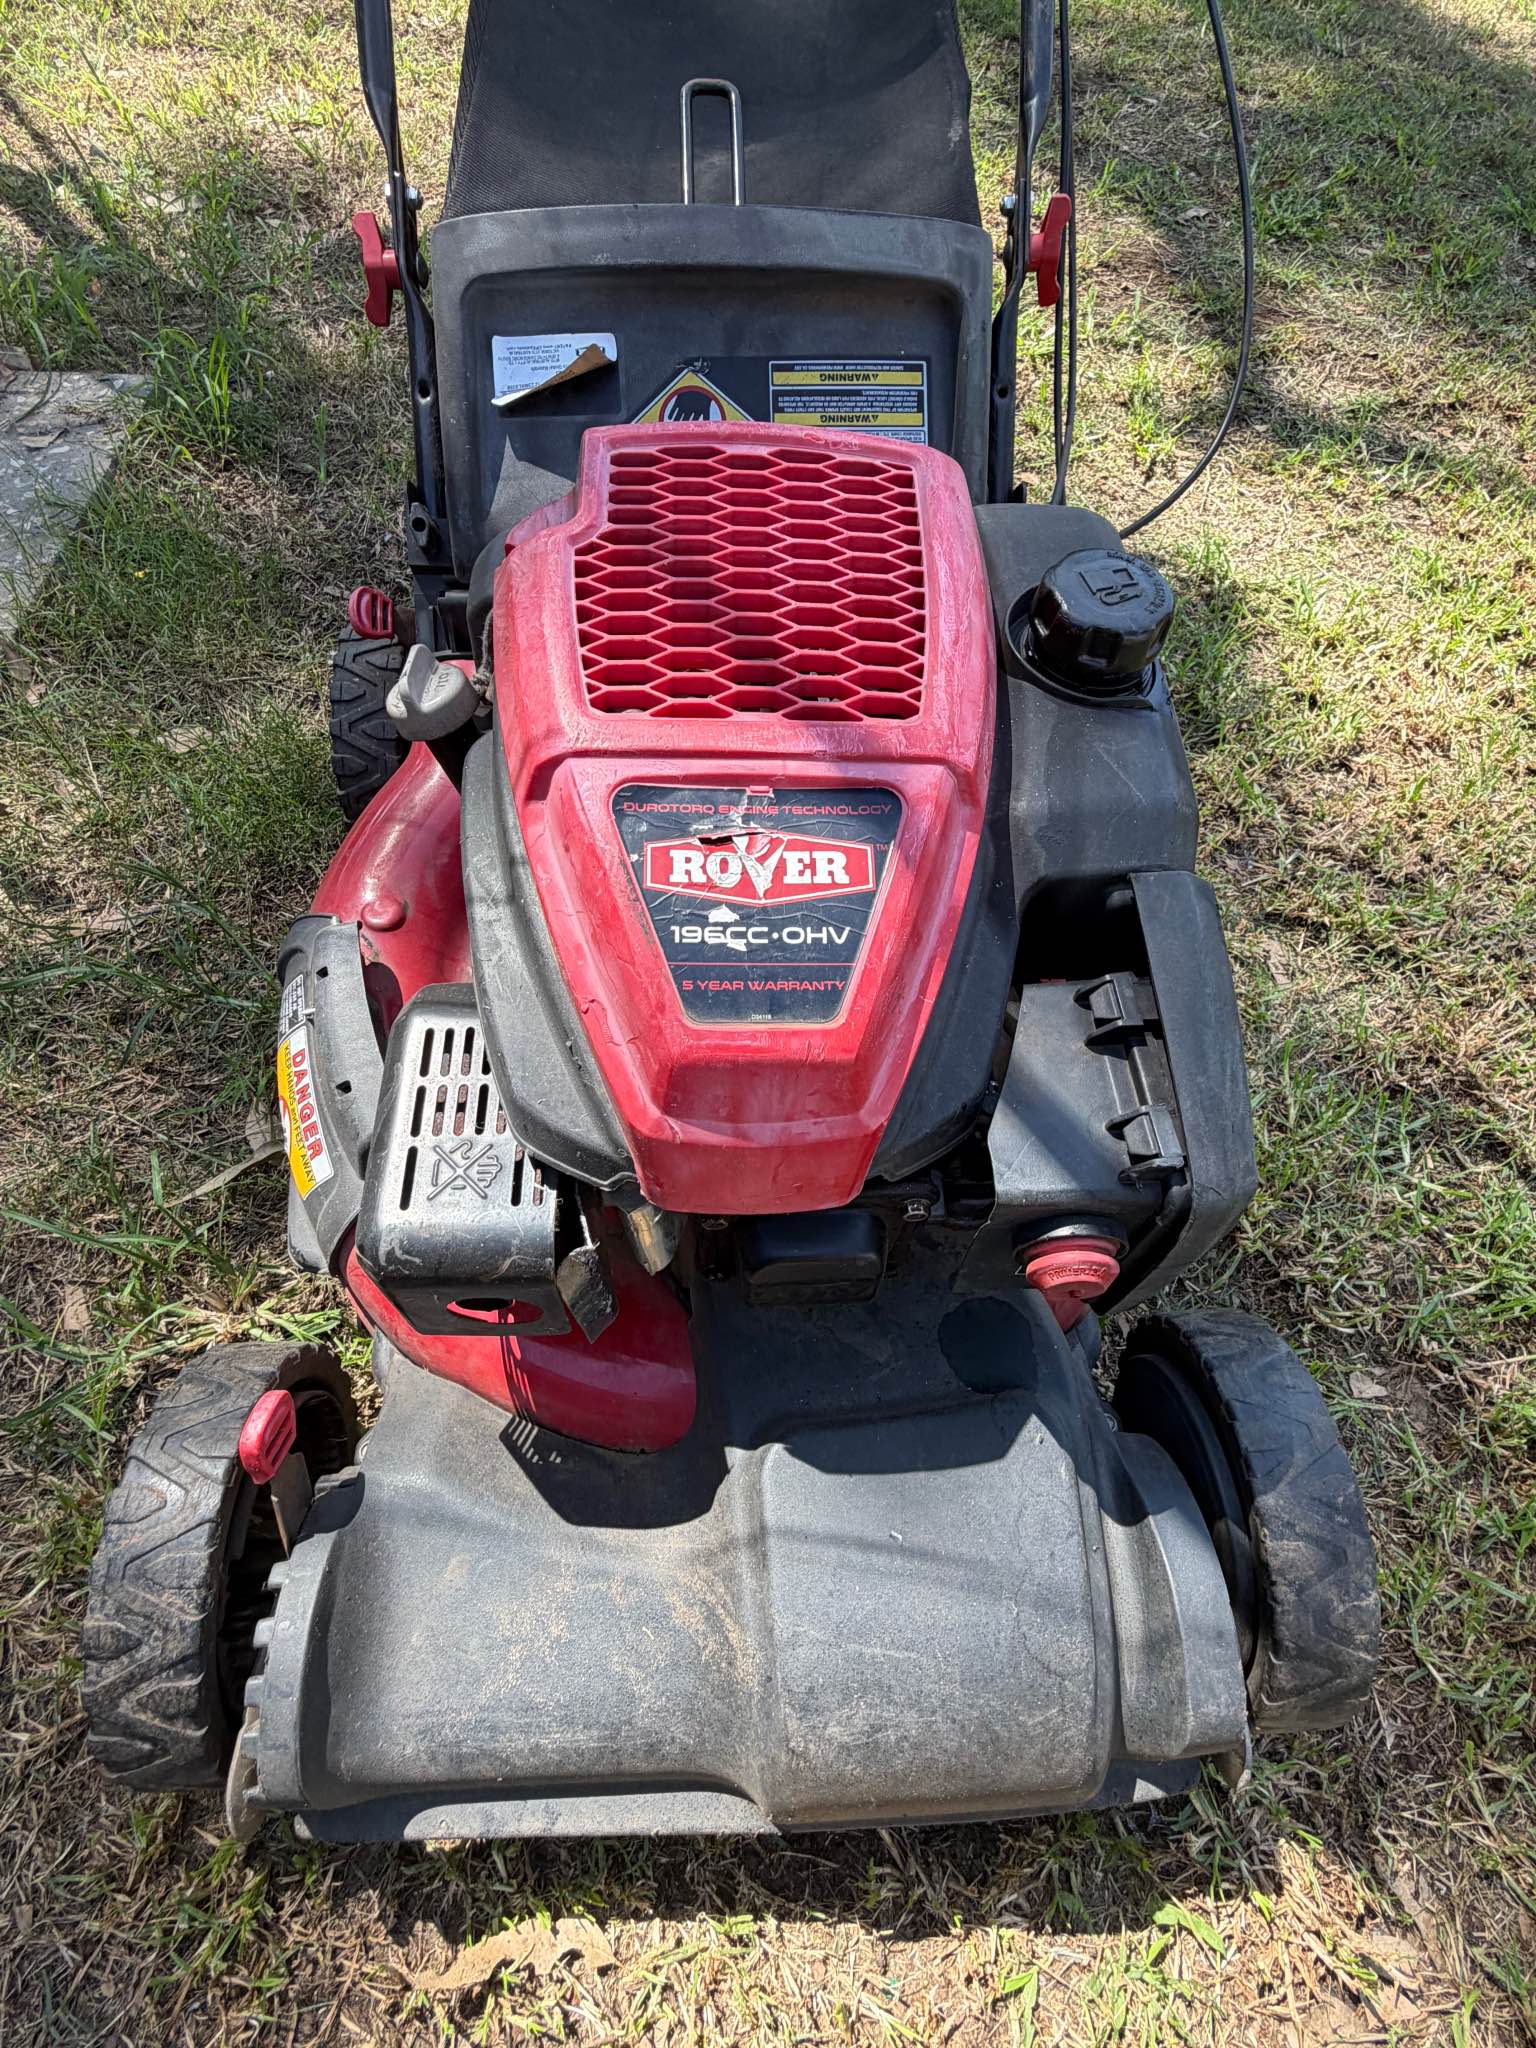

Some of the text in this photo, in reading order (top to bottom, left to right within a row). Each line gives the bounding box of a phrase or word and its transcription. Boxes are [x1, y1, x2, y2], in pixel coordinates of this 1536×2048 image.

[820, 373, 871, 382] WARNING
[820, 414, 871, 423] WARNING
[623, 803, 892, 816] DUROTORQ ENGINE TECHNOLOGY
[669, 837, 850, 899] ROVER
[682, 980, 845, 992] 5 YEAR WARRANTY
[284, 1046, 293, 1069] KEEP
[286, 1070, 296, 1105] HANDS
[292, 1048, 323, 1161] DANGER
[294, 1126, 306, 1151] FEET
[300, 1153, 316, 1183] AWAY
